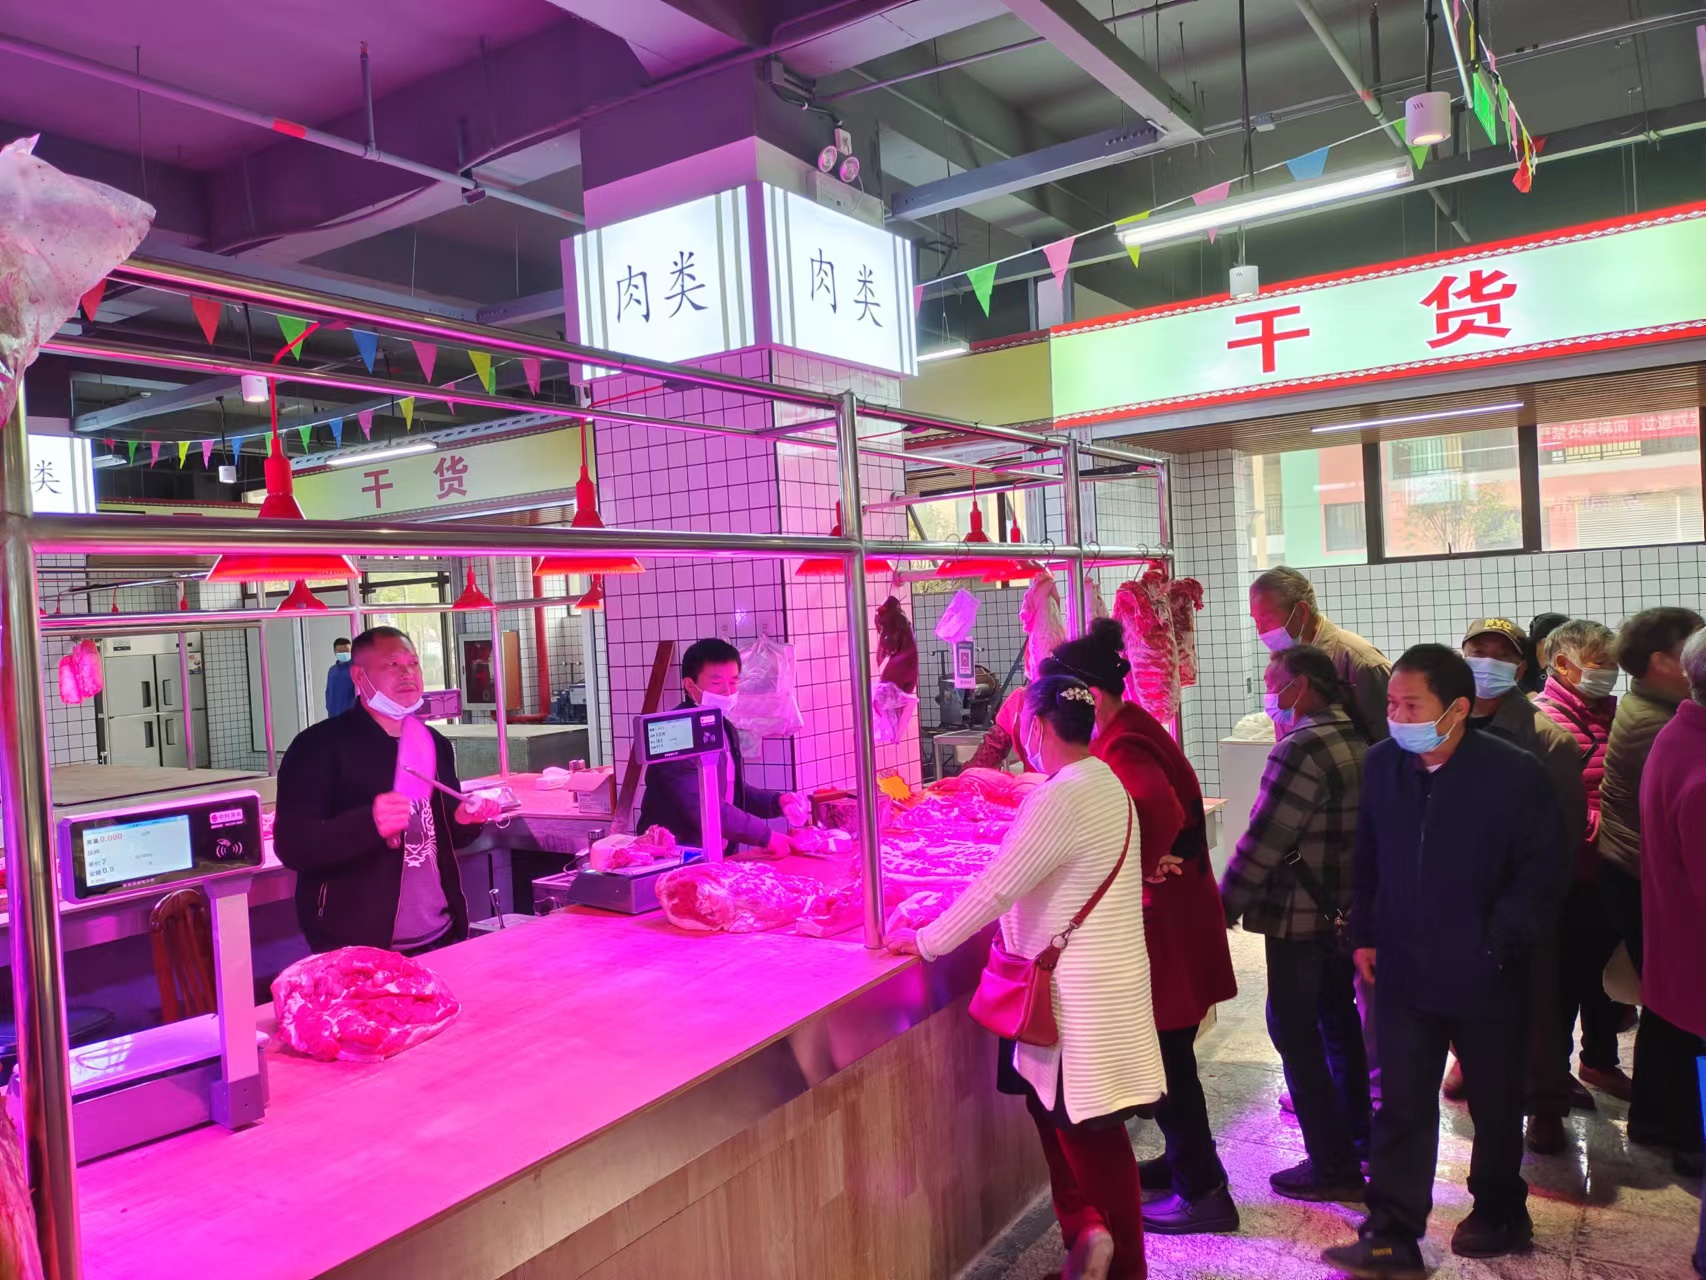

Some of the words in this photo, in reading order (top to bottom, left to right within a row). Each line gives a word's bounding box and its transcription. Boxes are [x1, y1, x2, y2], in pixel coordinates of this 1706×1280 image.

[615, 250, 709, 324] 肉类
[810, 247, 883, 328] 肉类
[1227, 269, 1518, 374] 干货
[32, 459, 62, 494] 类
[361, 455, 469, 509] 干货
